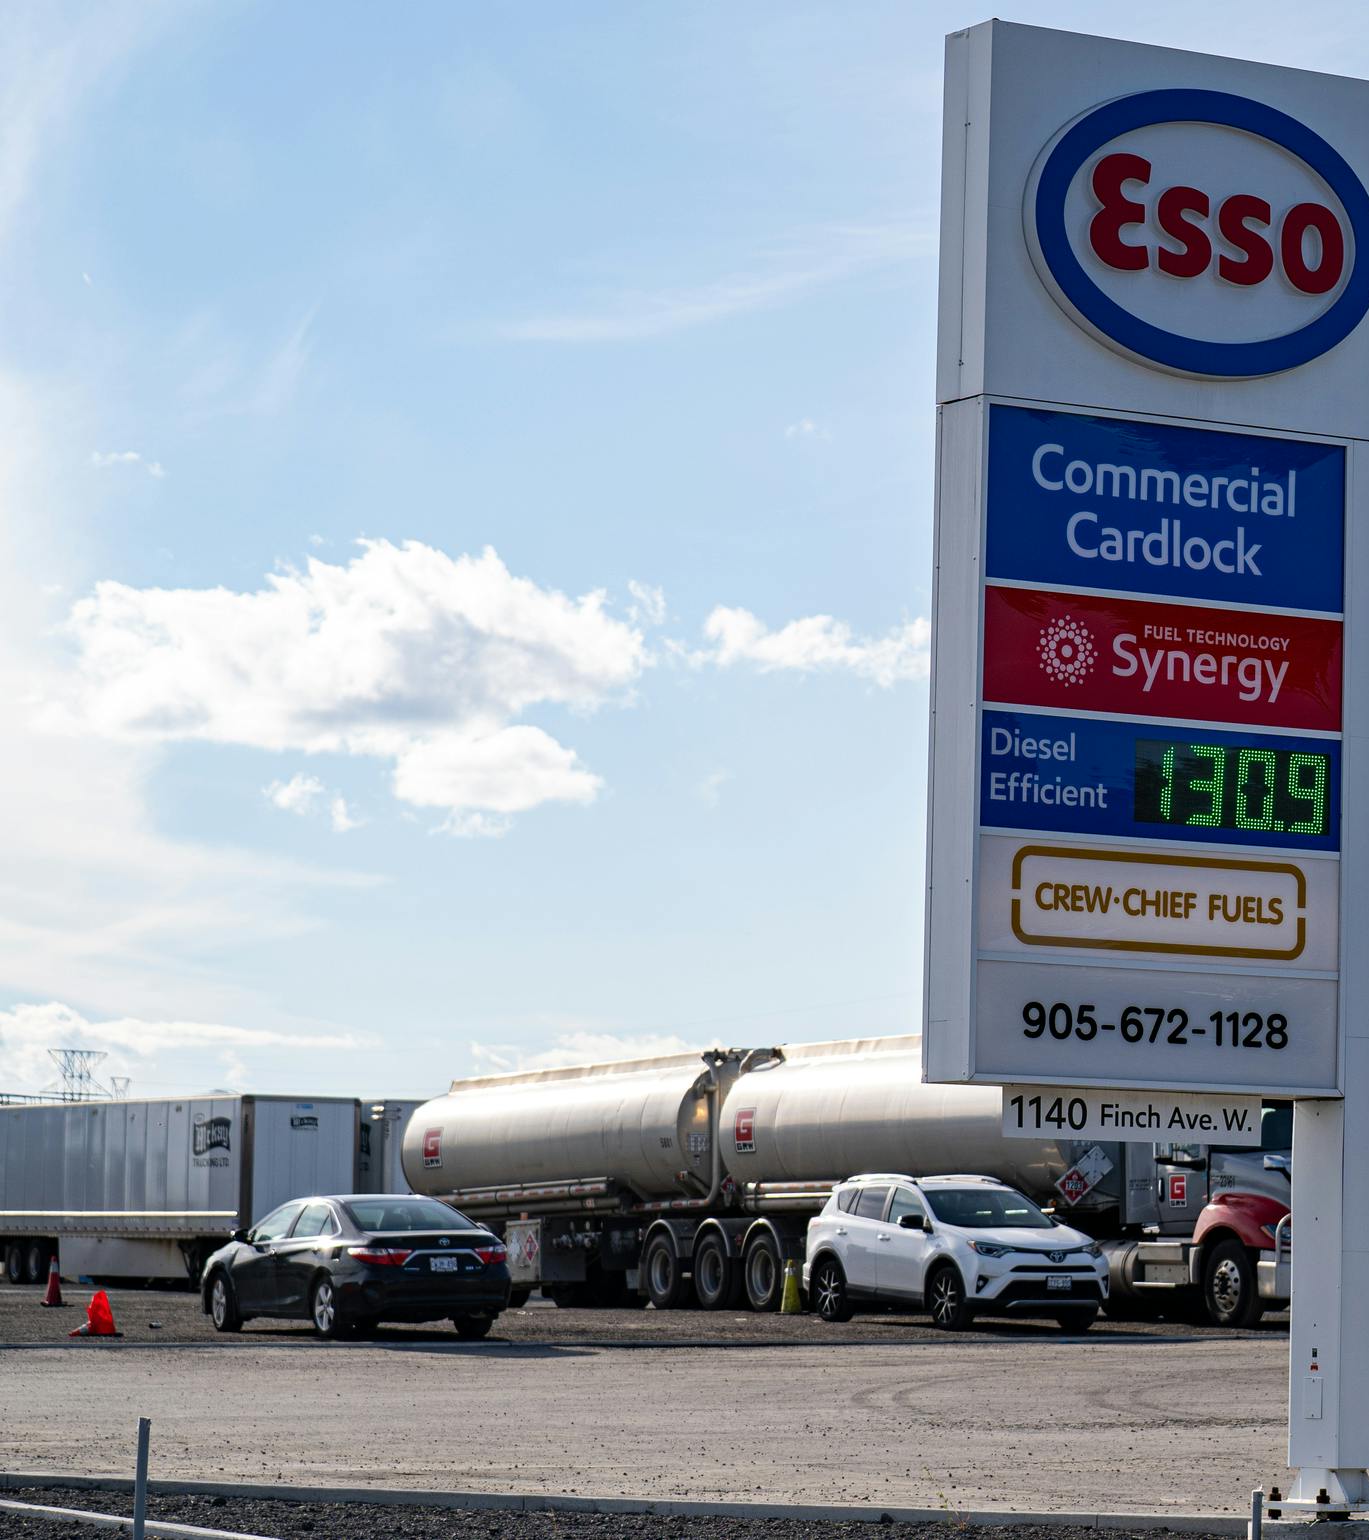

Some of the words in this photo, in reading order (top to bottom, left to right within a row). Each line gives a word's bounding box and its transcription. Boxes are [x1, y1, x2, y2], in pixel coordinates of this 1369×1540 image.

[1089, 152, 1345, 295] Esso
[1032, 443, 1297, 518] Commercial
[1066, 511, 1263, 577] Cardlock
[1143, 624, 1182, 642] FUEL
[1186, 628, 1290, 652] TECHNOLOGY
[1112, 633, 1290, 704] Synergy
[990, 727, 1076, 762] Diesel
[989, 772, 1108, 809] Efficient
[1160, 744, 1326, 835] 130.9
[1208, 893, 1284, 926] FUELS
[1022, 1001, 1289, 1050] 905-672-1128
[1010, 1095, 1088, 1131] 1140
[1100, 1104, 1160, 1129] Finch
[1168, 1107, 1218, 1132] Ave.
[1225, 1109, 1253, 1132] W.
